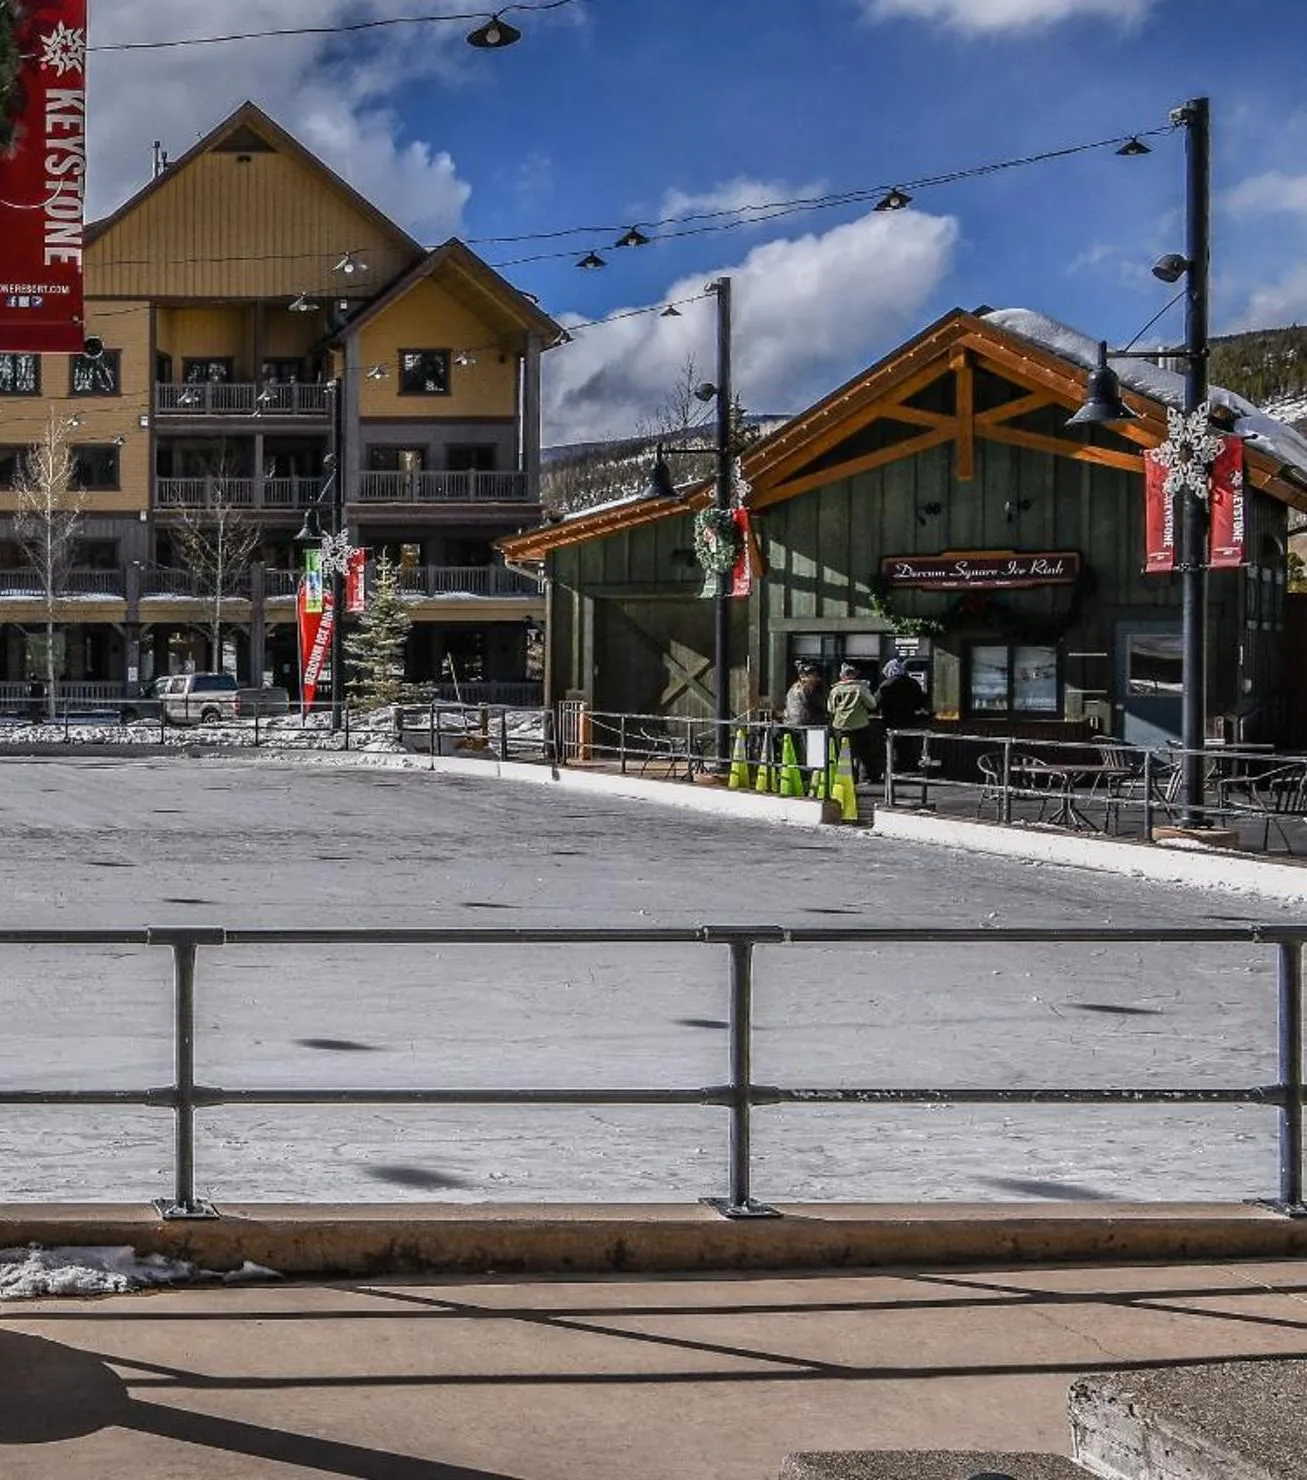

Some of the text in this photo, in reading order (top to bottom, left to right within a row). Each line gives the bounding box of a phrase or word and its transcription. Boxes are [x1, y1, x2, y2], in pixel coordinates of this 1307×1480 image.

[44, 88, 86, 267] KEYSTONE
[894, 558, 1064, 580] Dercum Square Ice Rink
